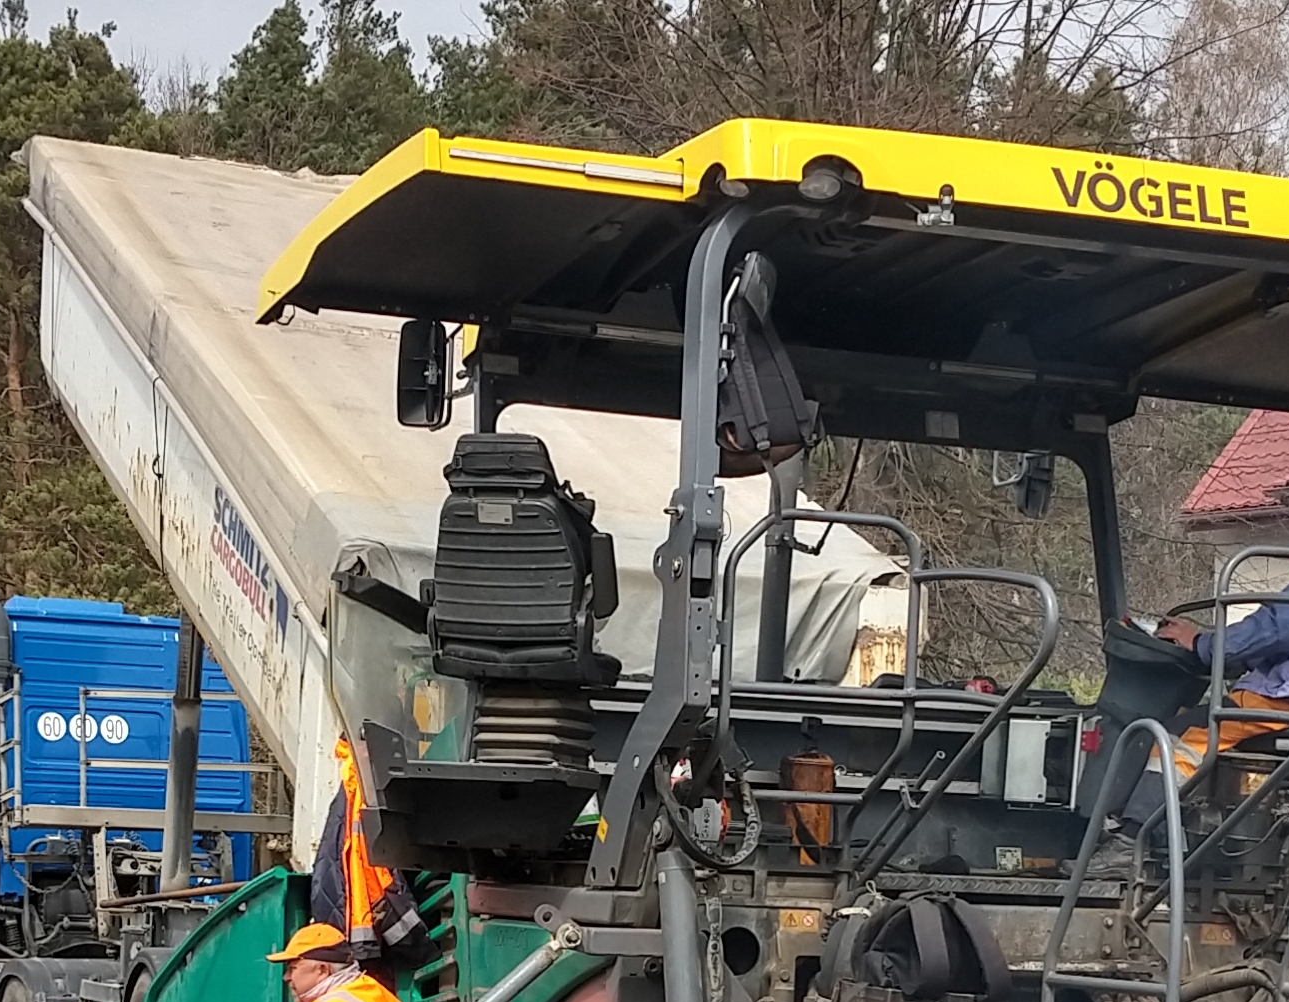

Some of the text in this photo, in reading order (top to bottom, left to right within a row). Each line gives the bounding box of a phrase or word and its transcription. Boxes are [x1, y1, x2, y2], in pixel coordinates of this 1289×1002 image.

[1050, 160, 1250, 228] VÖGELE
[213, 484, 270, 591] SCHMITZ
[210, 524, 267, 622] CARGOBULL
[43, 716, 61, 737] 60
[75, 717, 92, 738] 80
[106, 719, 123, 740] 90
